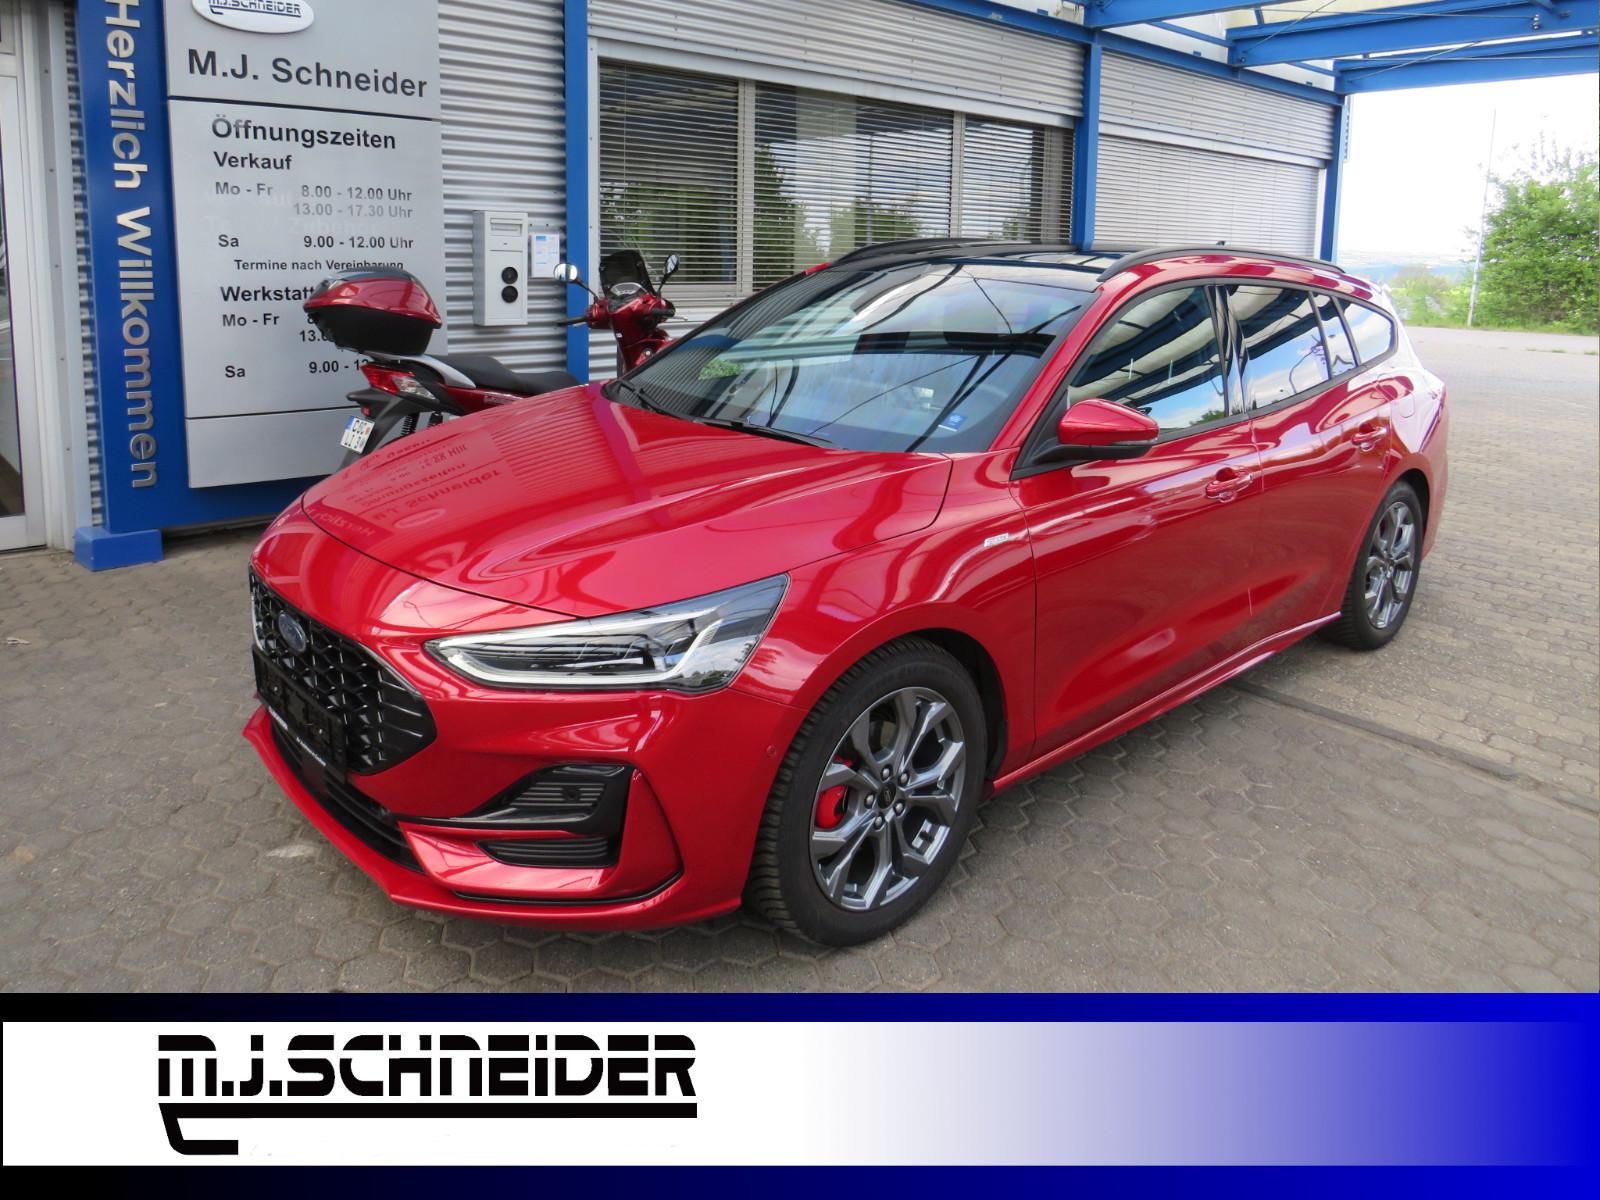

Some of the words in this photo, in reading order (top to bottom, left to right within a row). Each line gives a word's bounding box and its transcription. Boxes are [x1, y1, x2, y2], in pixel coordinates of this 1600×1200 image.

[188, 49, 259, 81] M.J.
[271, 57, 427, 97] Schneider
[105, 0, 149, 189] Herzlich
[212, 114, 396, 149] Öffnungszeiten
[213, 151, 292, 170] Verkauf
[215, 182, 240, 195] Mo
[256, 183, 273, 196] Fr
[301, 185, 332, 198] 8.00
[347, 187, 383, 200] 12.00
[388, 189, 412, 201] Uhr
[294, 203, 333, 216] 13.00
[348, 204, 384, 217] 17.30
[388, 206, 413, 218] Uhr
[218, 234, 240, 248] Sa
[304, 236, 334, 248] 9.00
[349, 236, 385, 249] 12.00
[390, 236, 414, 249] Uhr
[234, 259, 287, 270] Termine
[291, 259, 322, 270] nach
[222, 314, 247, 327] Mo
[263, 313, 280, 326] Fr
[116, 206, 157, 488] Willkommen
[225, 365, 246, 378] Sa
[309, 361, 339, 373] 9.00
